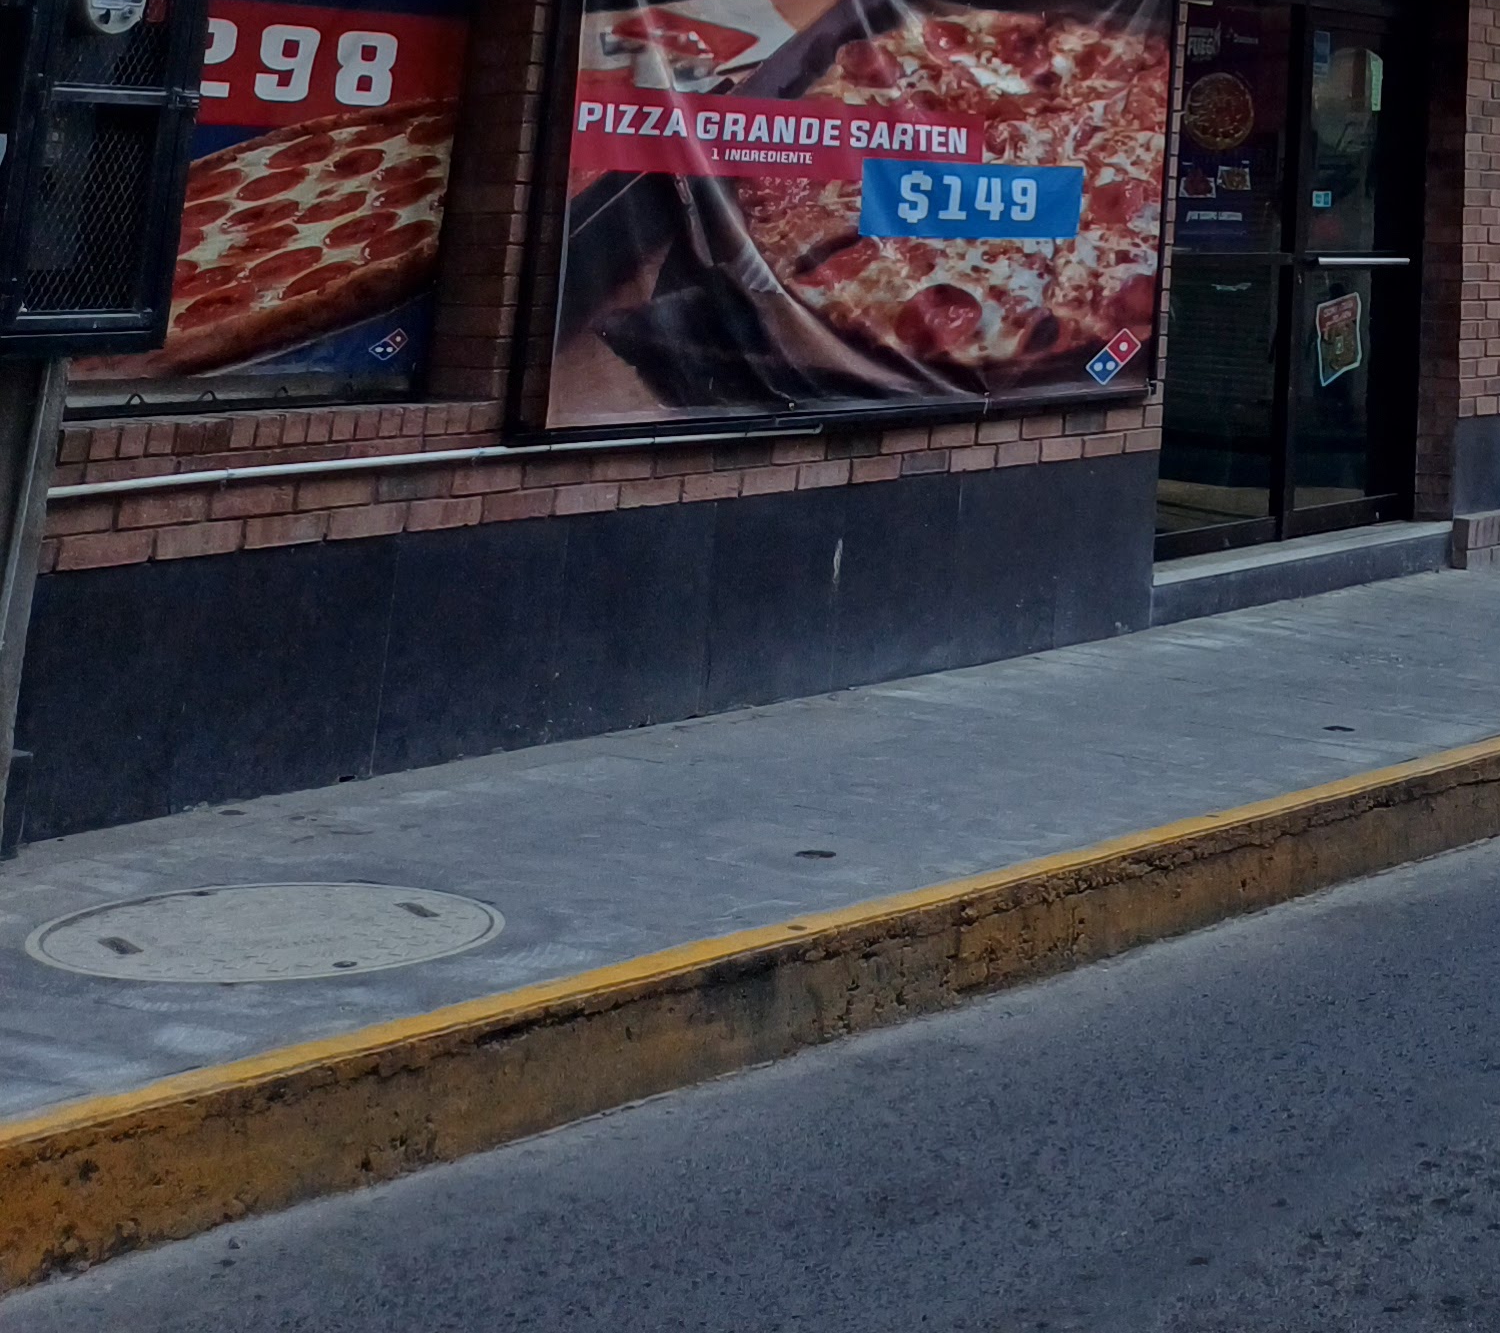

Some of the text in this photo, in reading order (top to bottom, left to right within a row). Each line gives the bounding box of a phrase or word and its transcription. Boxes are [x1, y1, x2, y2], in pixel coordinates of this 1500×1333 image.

[577, 101, 968, 155] PIZZA GRANDE SARTEN
[711, 148, 720, 161] 1
[897, 170, 1038, 223] $149
